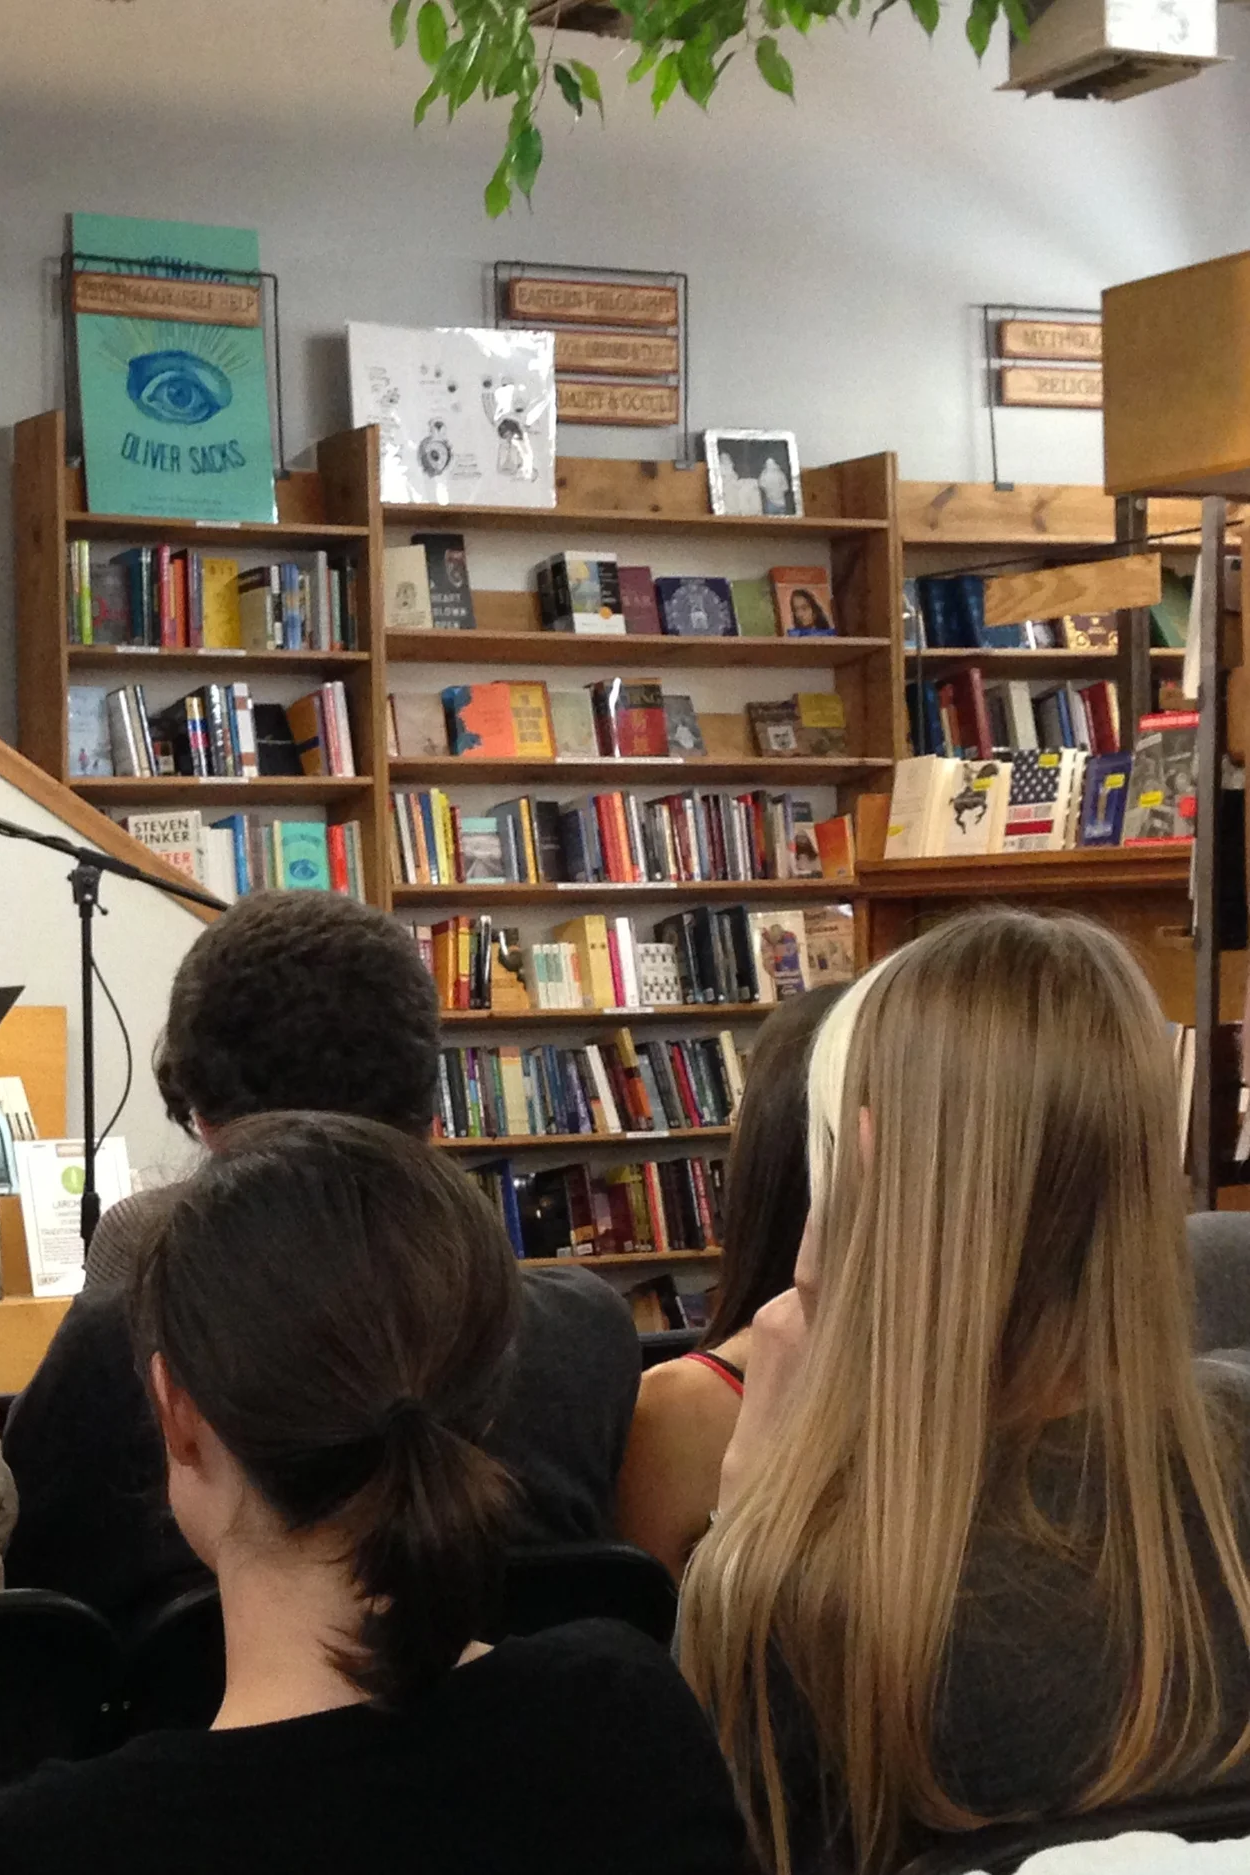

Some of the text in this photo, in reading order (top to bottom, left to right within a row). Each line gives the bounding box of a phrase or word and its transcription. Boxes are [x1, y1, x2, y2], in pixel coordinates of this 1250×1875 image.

[121, 431, 247, 475] OLIVER SACKS
[134, 818, 189, 833] STEVEN
